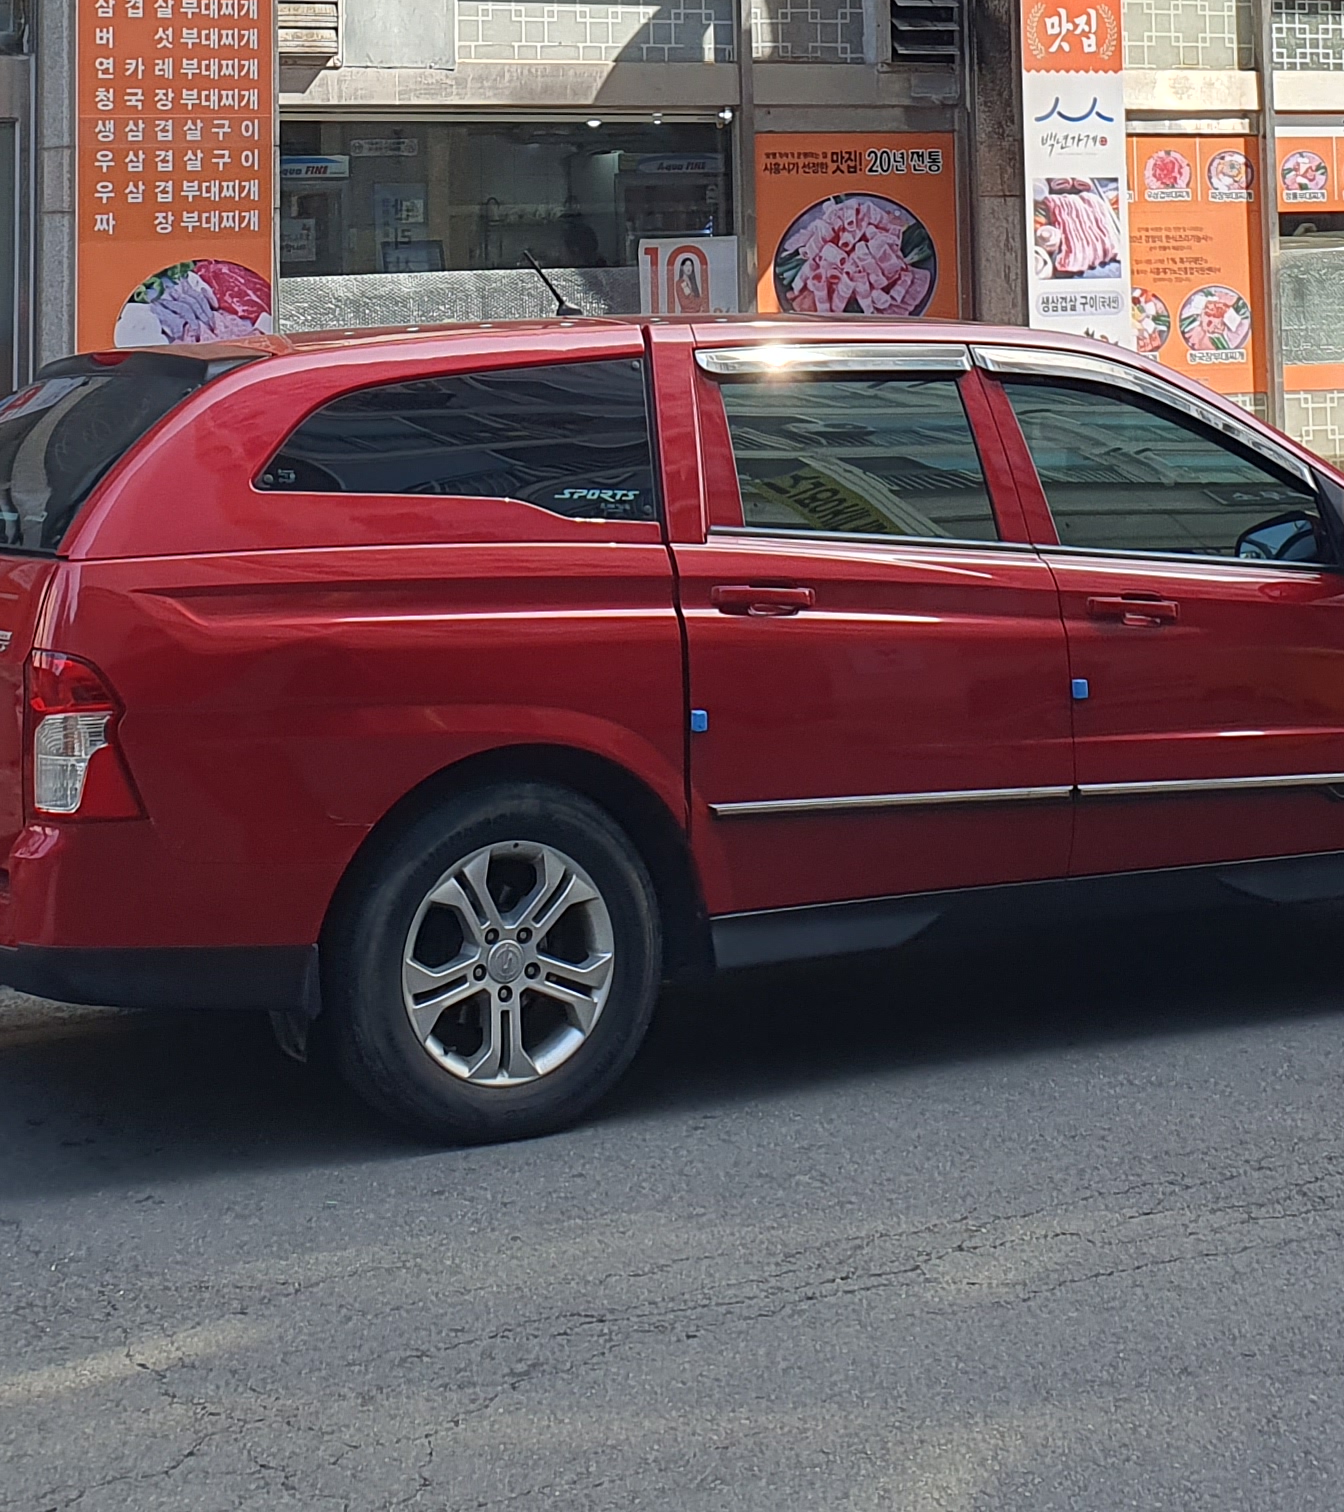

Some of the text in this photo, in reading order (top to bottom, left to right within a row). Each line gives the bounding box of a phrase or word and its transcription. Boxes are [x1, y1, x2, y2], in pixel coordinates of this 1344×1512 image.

[179, 28, 259, 50] 부대찌개
[1045, 6, 1100, 54] 맛집
[179, 58, 259, 80] 부대찌개
[179, 89, 259, 110] 부대찌개
[763, 148, 943, 176] 시흥시가 선정한 맛집! 20년 전통
[179, 180, 259, 203] 부대찌개
[179, 210, 259, 233] 부대찌개
[1040, 294, 1078, 313] 생삼겹살
[554, 488, 640, 503] SPORTS
